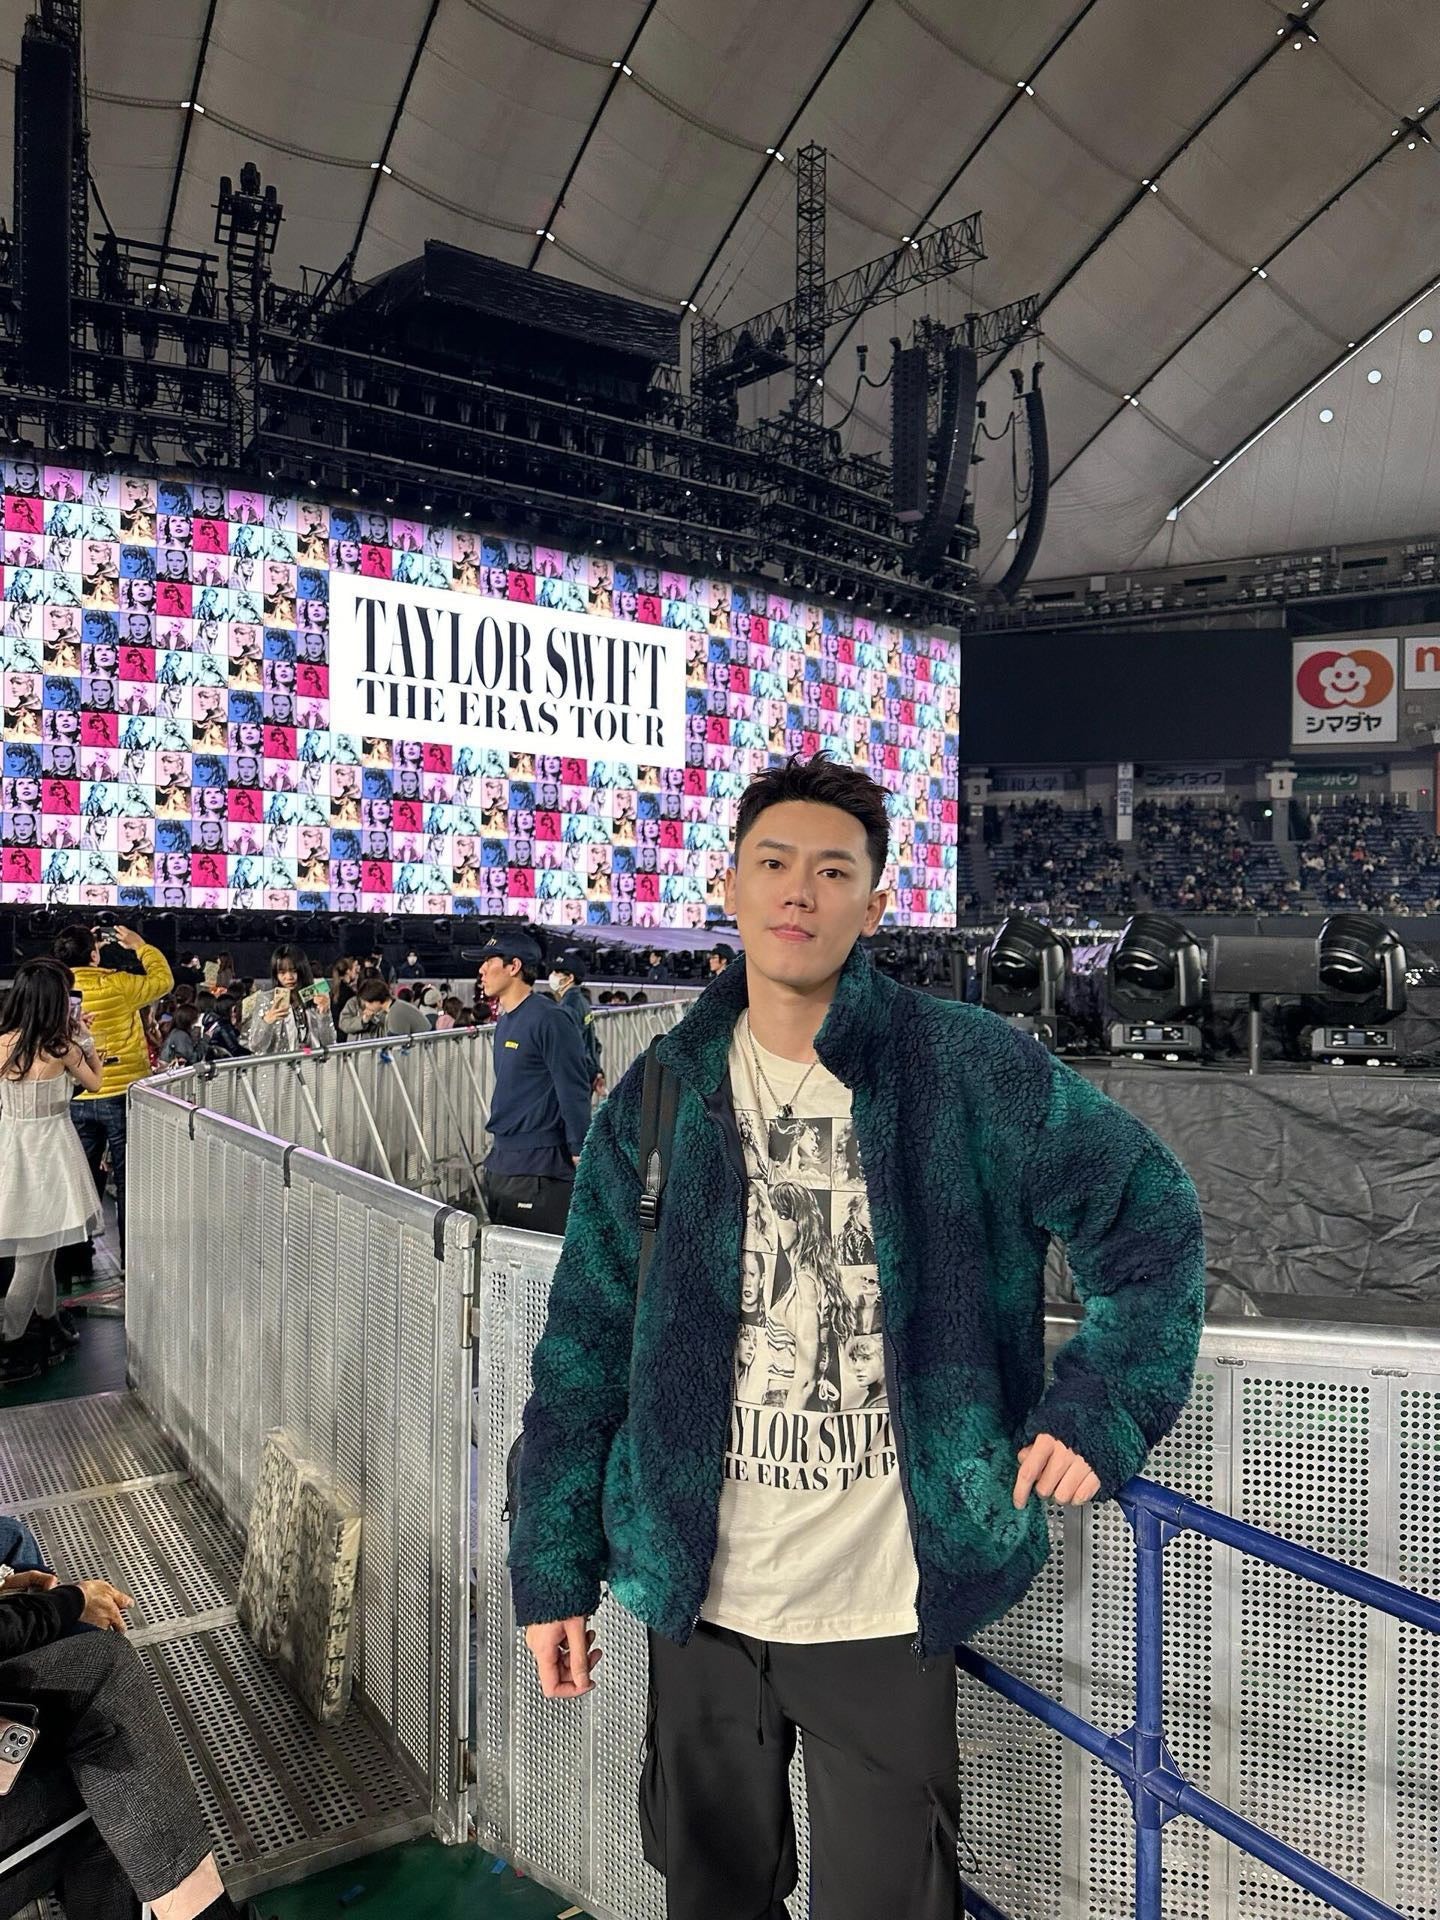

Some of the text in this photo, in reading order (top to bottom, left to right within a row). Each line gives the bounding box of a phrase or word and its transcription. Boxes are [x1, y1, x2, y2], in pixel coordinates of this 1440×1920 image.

[355, 597, 667, 710] TAYLOR SWIFT
[357, 678, 665, 747] THE ERAS TOUR
[1306, 712, 1382, 734] シマダヤ
[727, 1407, 809, 1464] YLOR
[758, 1464, 828, 1491] ERAS
